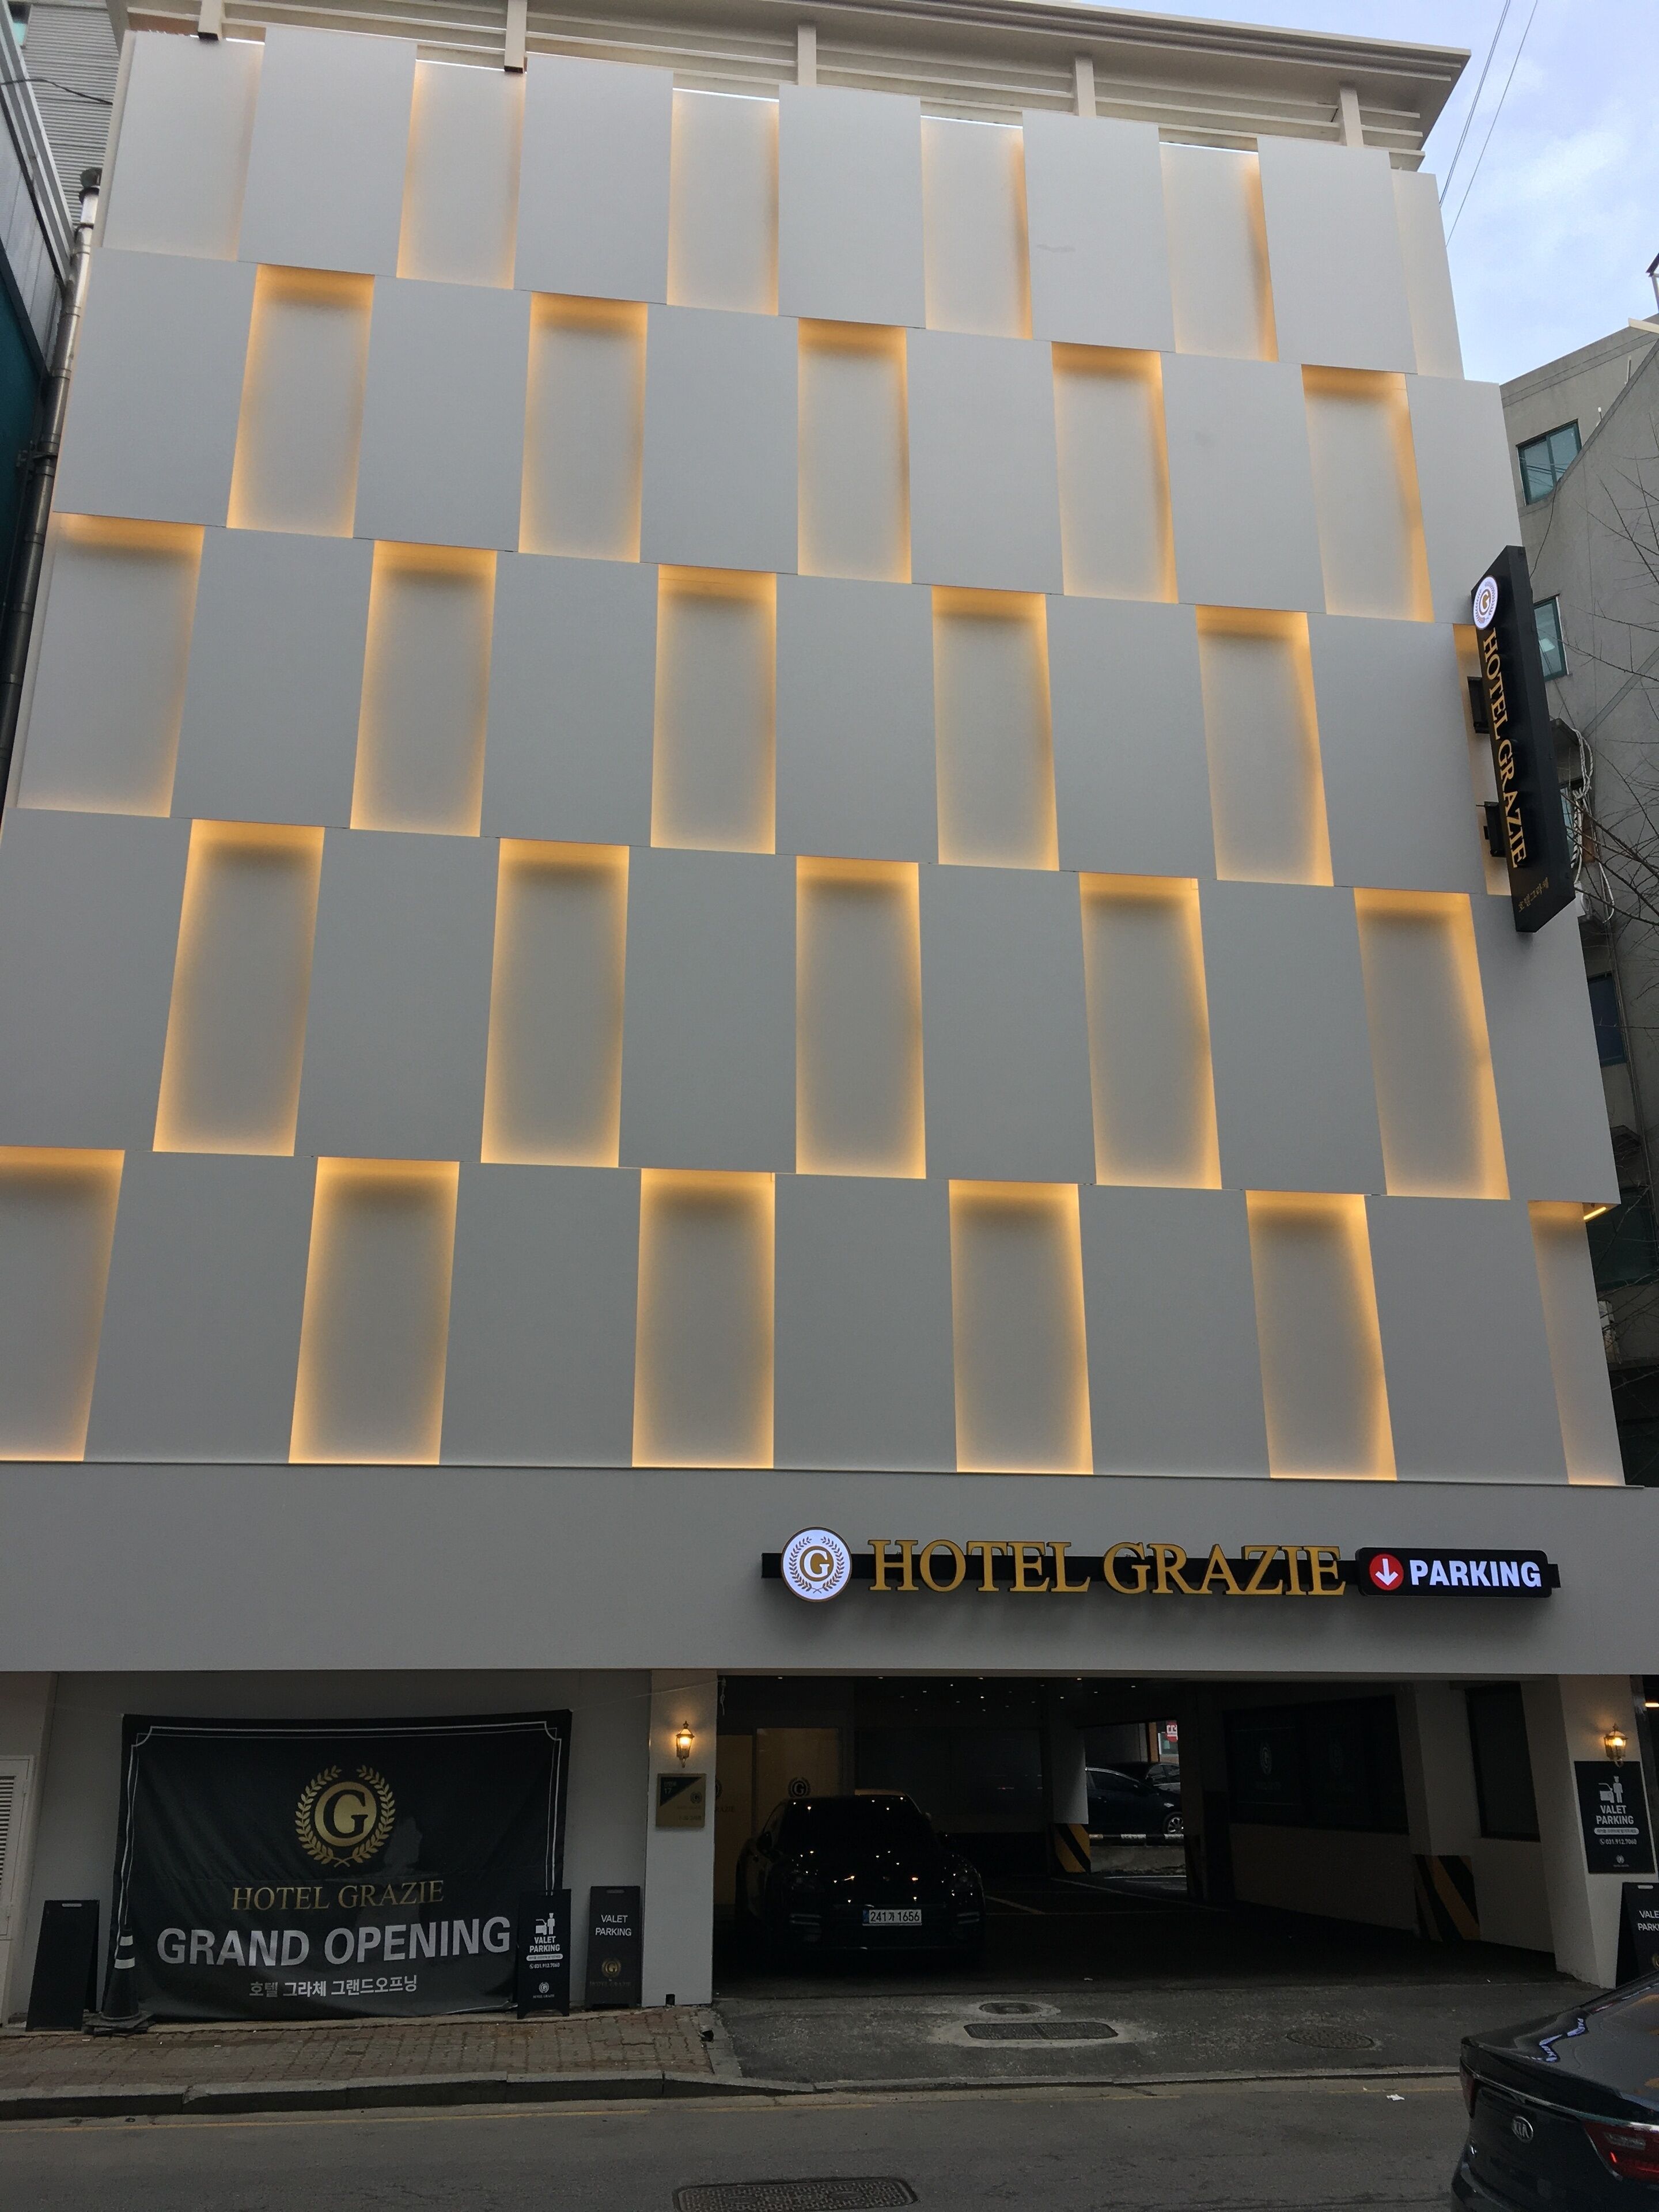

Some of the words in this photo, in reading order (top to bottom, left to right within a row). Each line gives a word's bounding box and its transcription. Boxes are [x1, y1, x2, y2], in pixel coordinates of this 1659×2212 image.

[1483, 627, 1509, 741] HOTEL
[1498, 739, 1528, 869] GRAZIE
[803, 1549, 831, 1578] G
[868, 1539, 1092, 1593] HOTEL
[1102, 1541, 1347, 1597] GRAZIE
[1410, 1559, 1543, 1588] PARKING
[323, 1789, 369, 1839] G
[1596, 1815, 1634, 1825] PARKING
[1600, 1805, 1627, 1814] VALET
[231, 1886, 330, 1911] HOTEL
[338, 1880, 444, 1909] GRAZIE
[600, 1914, 628, 1923] VALET
[156, 1927, 310, 1967] GRAND
[324, 1915, 511, 1965] OPENING
[533, 1936, 556, 1944] VALET
[595, 1927, 632, 1937] PARKING
[529, 1944, 560, 1953] PARKING
[248, 1980, 279, 1998] 호텔
[282, 1980, 327, 1998] 그라체
[330, 1974, 418, 1996] 그랜드오프닝
